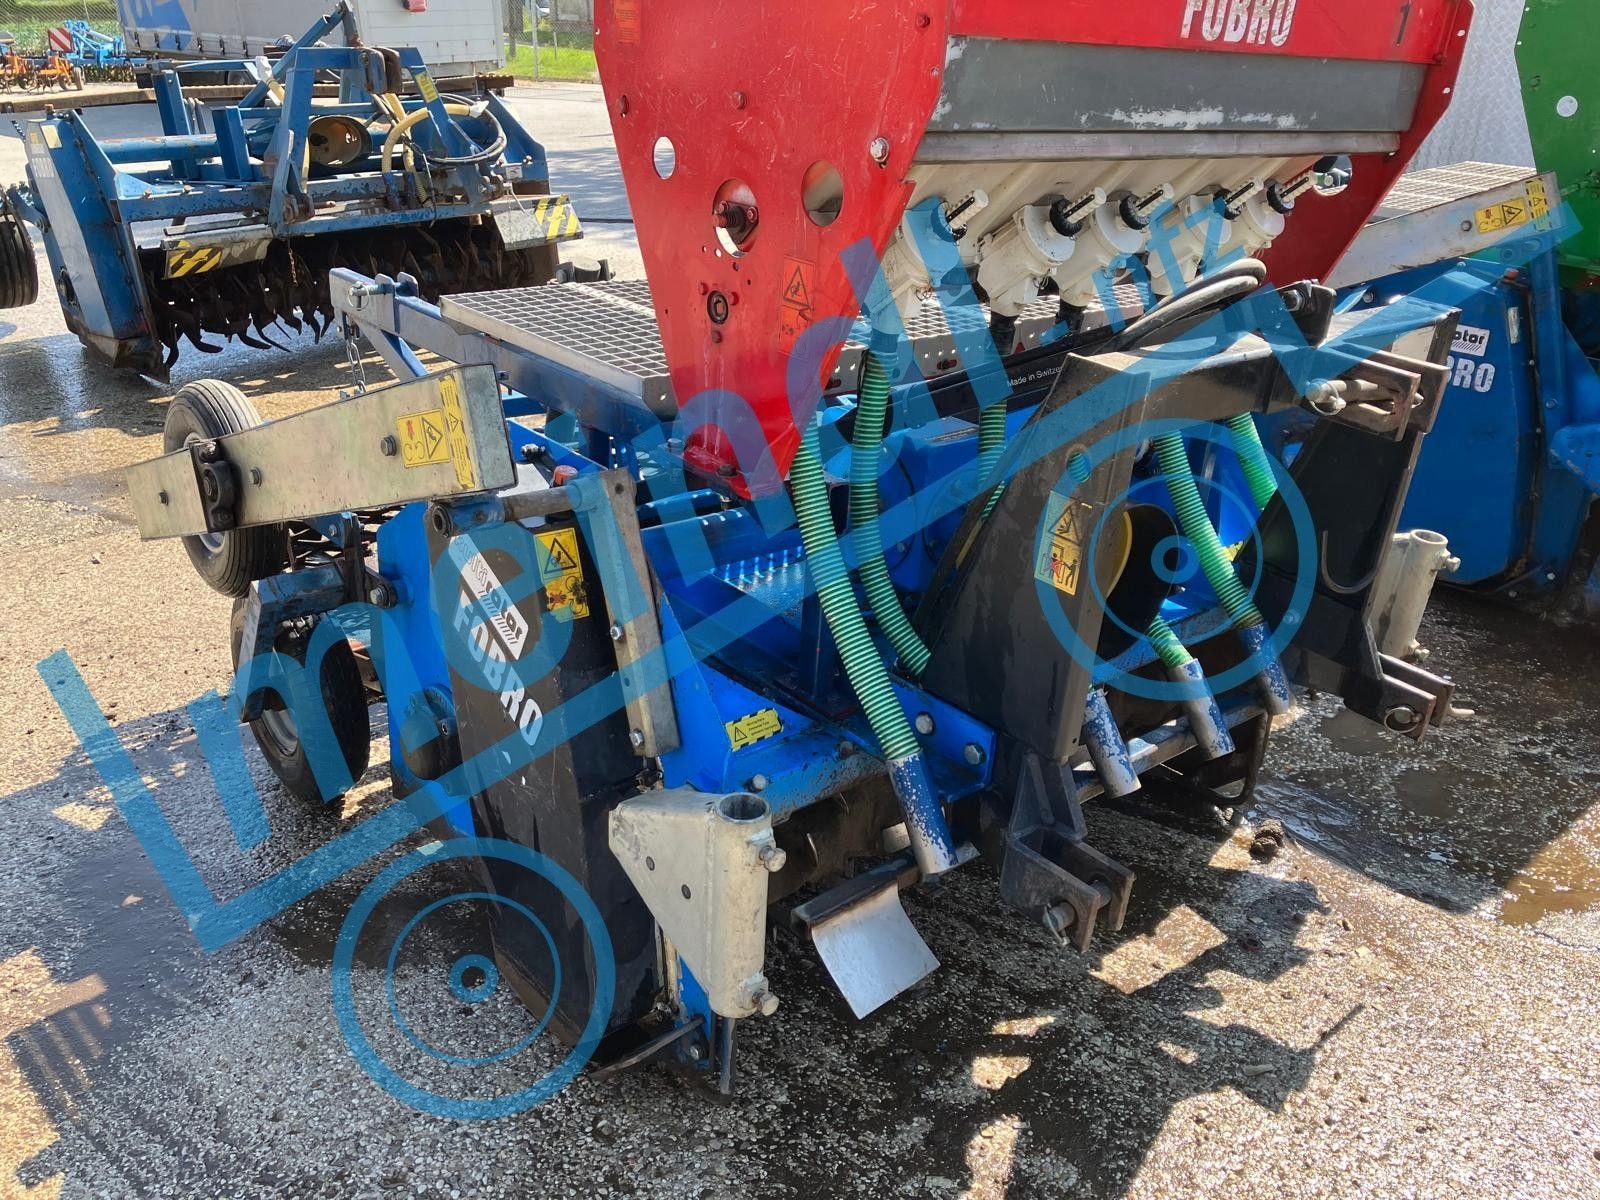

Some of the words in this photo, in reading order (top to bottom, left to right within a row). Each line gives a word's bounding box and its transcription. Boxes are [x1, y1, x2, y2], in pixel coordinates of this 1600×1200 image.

[1180, 0, 1297, 47] FOBRO
[1007, 376, 1027, 388] Made
[1028, 373, 1036, 381] in
[454, 589, 544, 746] FOBRO
